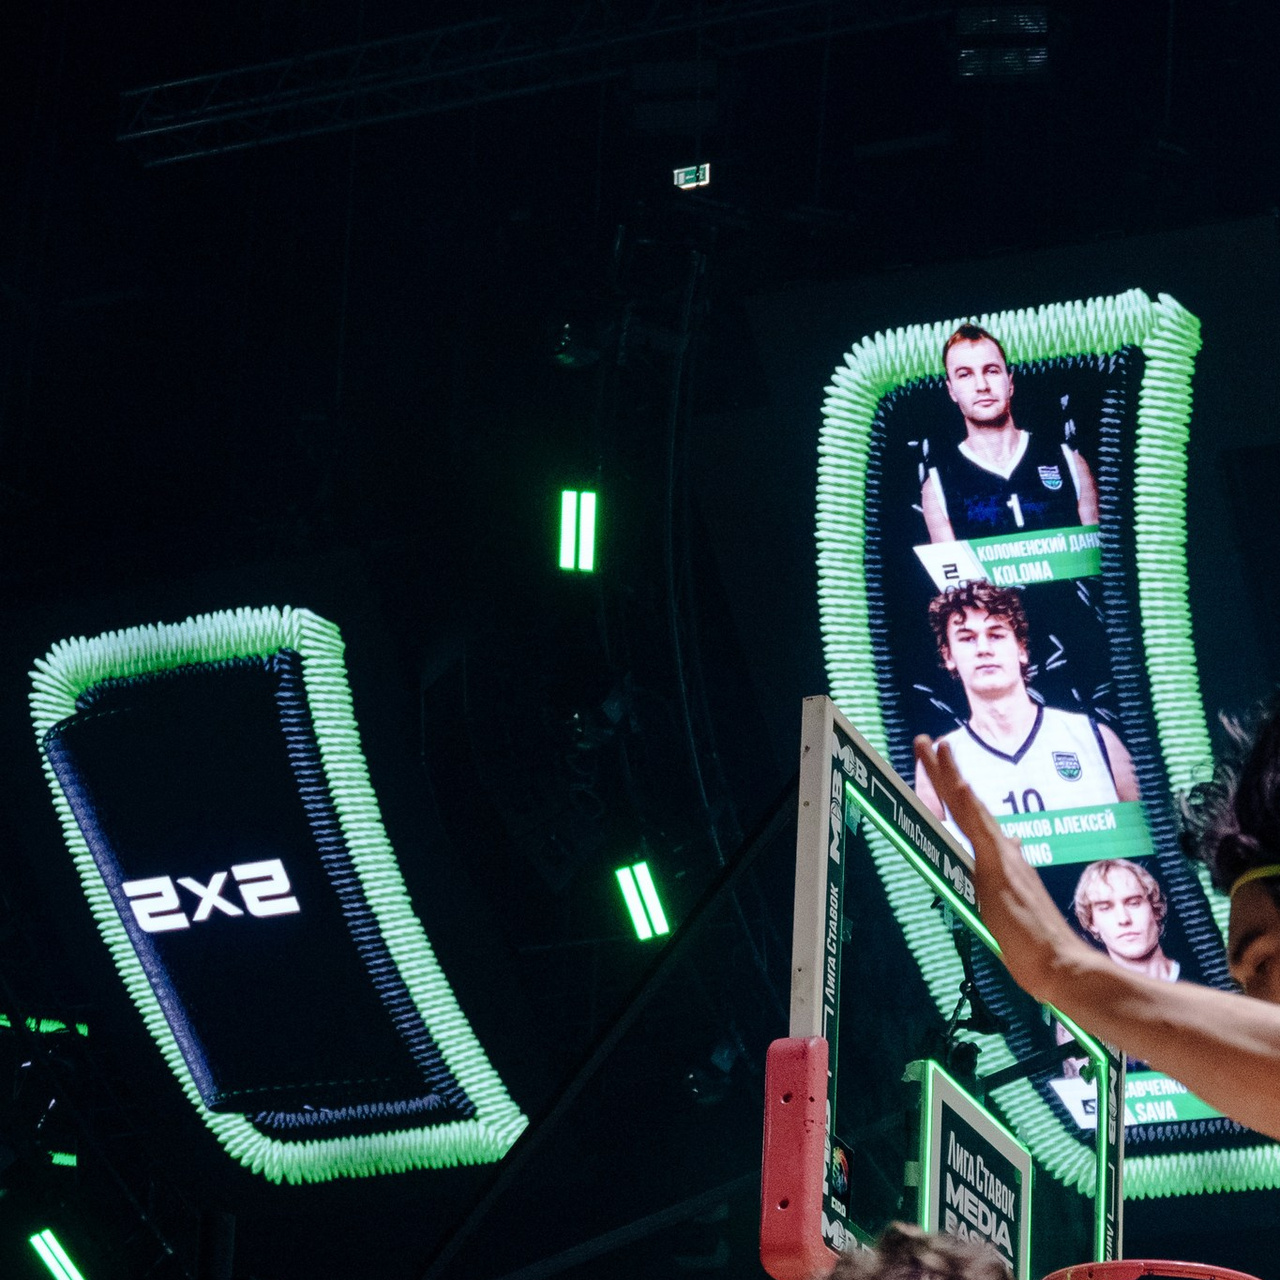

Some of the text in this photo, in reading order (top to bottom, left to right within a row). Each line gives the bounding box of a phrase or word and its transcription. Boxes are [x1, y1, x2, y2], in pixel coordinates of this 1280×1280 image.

[1007, 494, 1024, 527] 1
[977, 534, 1067, 562] КОЛОМЕНСКИЙ
[992, 561, 1053, 586] KOLOMA
[899, 806, 941, 869] ЛИГА СТАВОК
[1054, 808, 1117, 835] АЛЕКСЕЙ
[121, 858, 300, 935] 2X2
[825, 882, 839, 1004] ЛИГА СТАВОК
[1135, 1100, 1178, 1123] SAVA
[948, 1130, 1015, 1222] ЛИГА СТАВОК
[946, 1172, 1014, 1258] MEDIA
